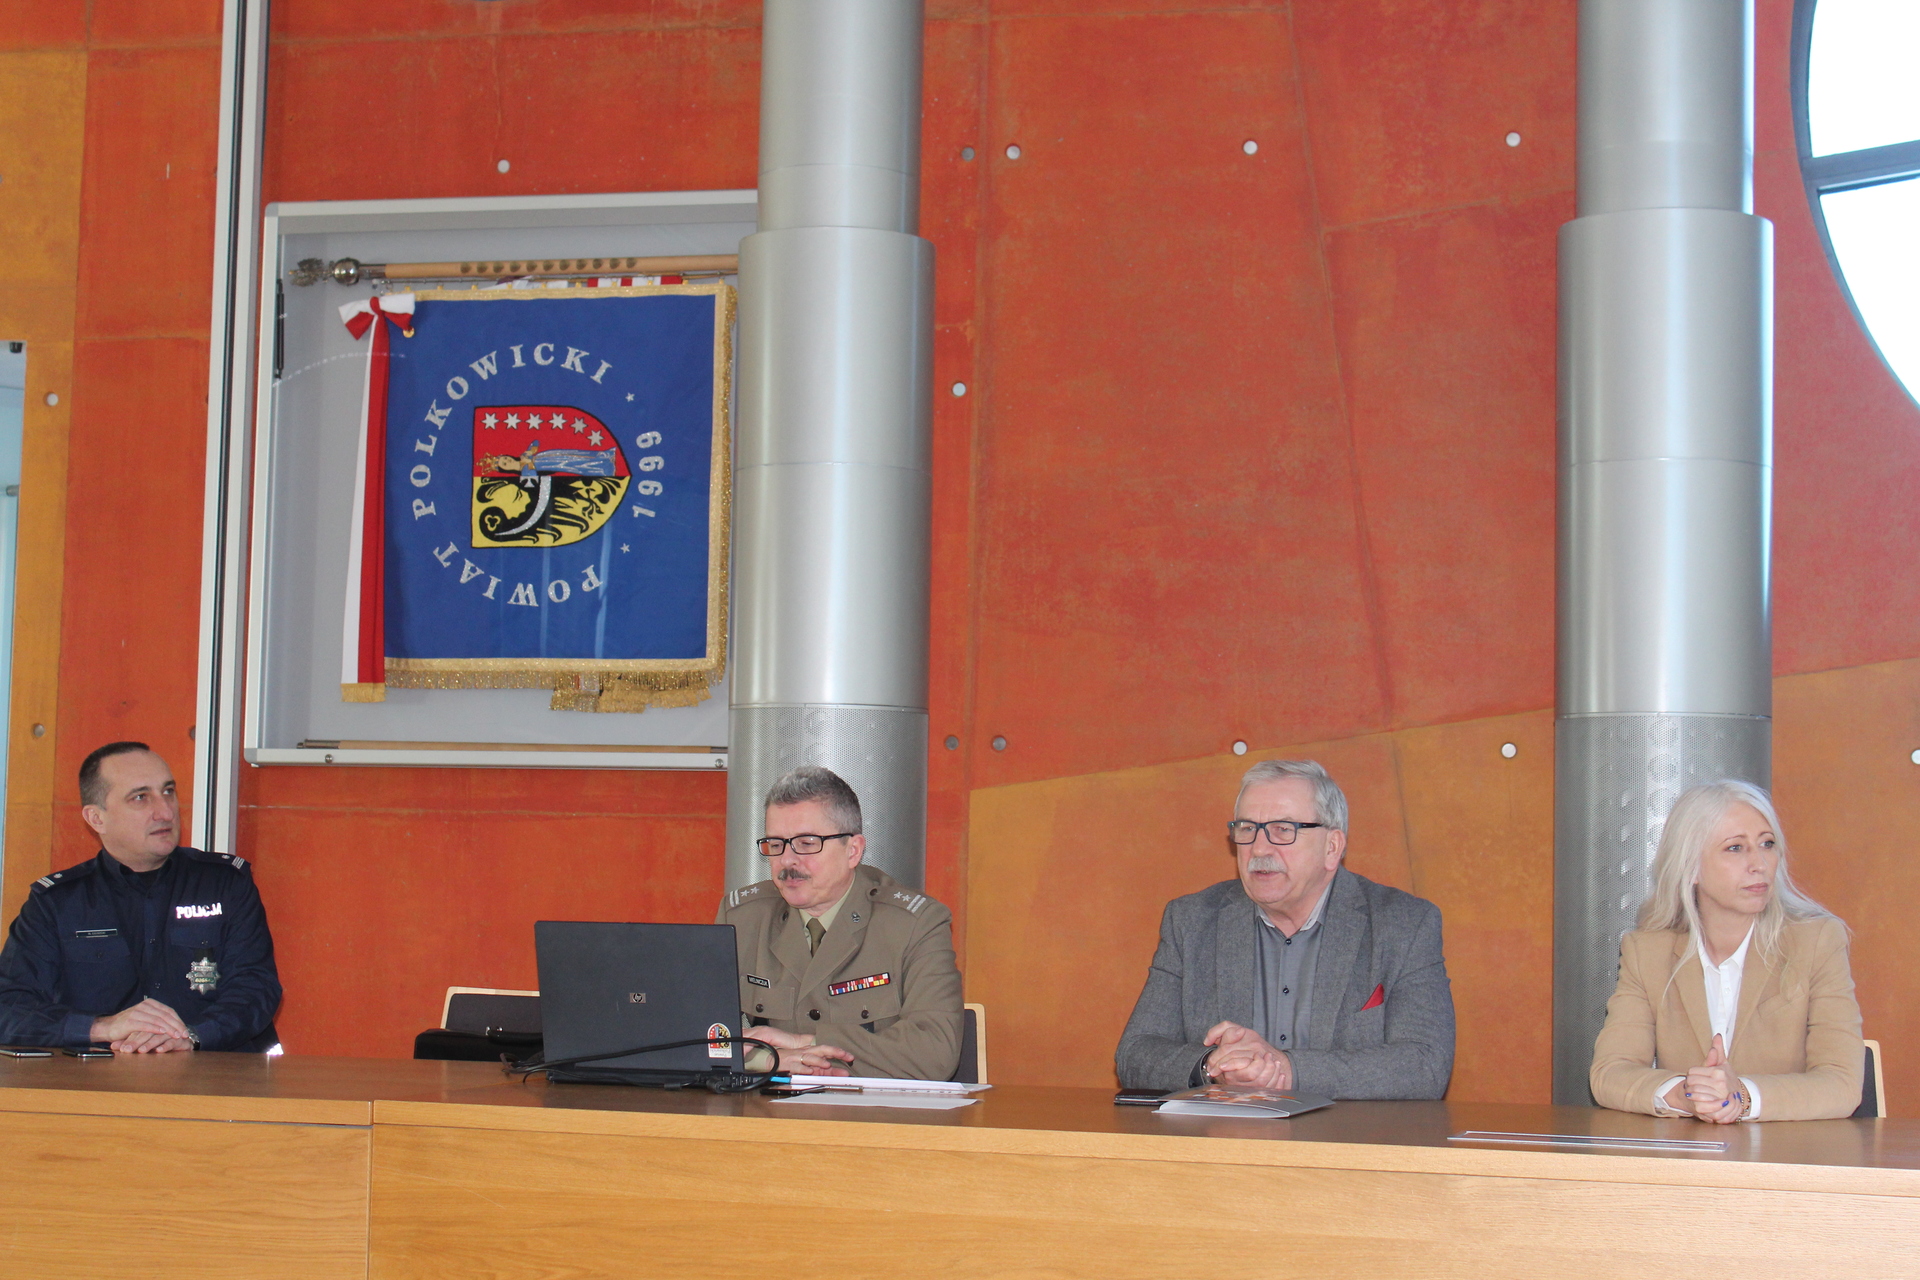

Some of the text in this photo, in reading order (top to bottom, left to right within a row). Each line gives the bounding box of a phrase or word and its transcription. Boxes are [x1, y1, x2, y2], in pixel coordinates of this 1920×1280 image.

[410, 342, 612, 607] POWIAT POLKOWICKI
[632, 430, 665, 518] 1999
[175, 902, 223, 919] POLICJA
